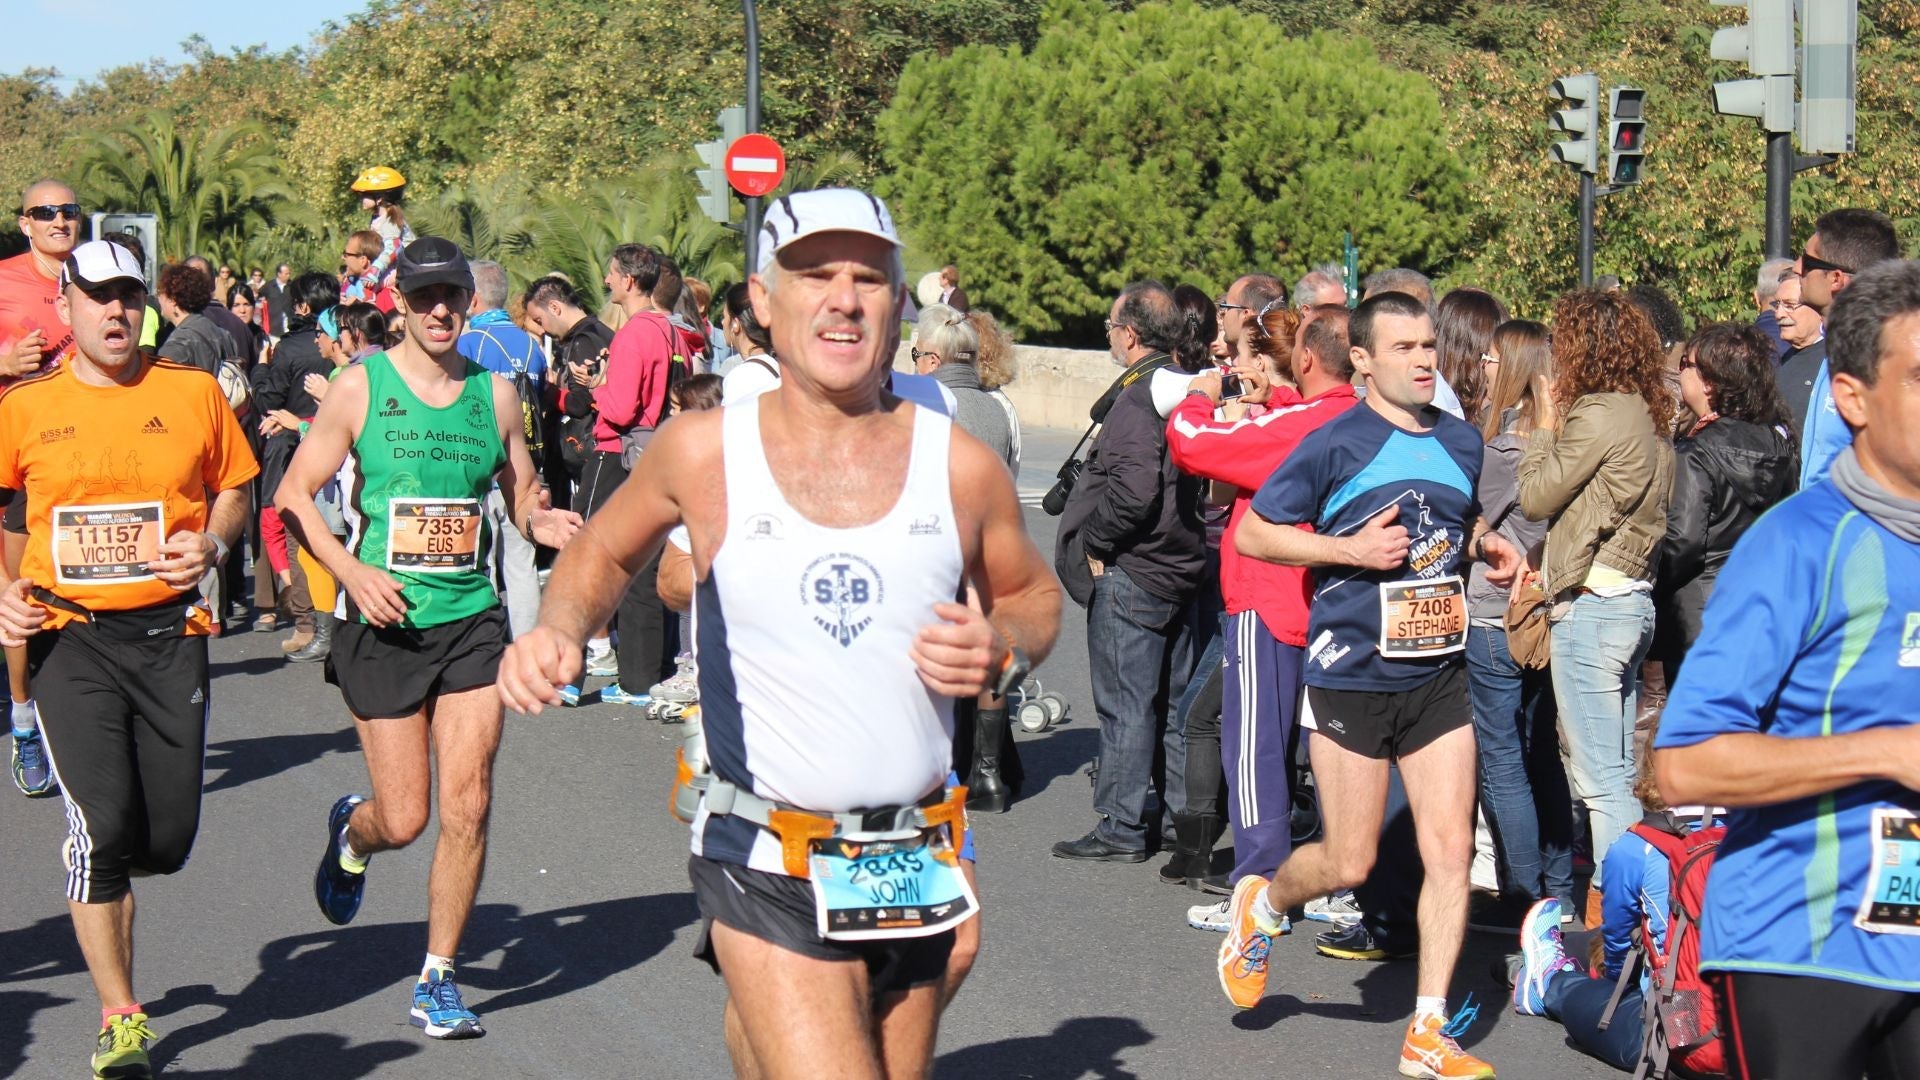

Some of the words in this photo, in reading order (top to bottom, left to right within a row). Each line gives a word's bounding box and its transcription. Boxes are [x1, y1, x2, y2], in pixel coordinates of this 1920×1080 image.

[379, 409, 408, 418] VIATOR
[385, 429, 420, 443] Club
[424, 429, 487, 449] Atletismo
[393, 447, 425, 459] Don
[430, 447, 481, 465] Quijote
[74, 524, 143, 544] 11157
[416, 518, 465, 535] 7353
[81, 545, 137, 563] VICTOR
[427, 537, 454, 553] EUS
[1410, 539, 1451, 572] VALENCIA
[1417, 551, 1451, 580] TRINIDAD
[1408, 597, 1452, 618] 7408
[1398, 616, 1460, 637] STEPHANE
[846, 852, 924, 885] 2849
[869, 877, 921, 905] JOHN
